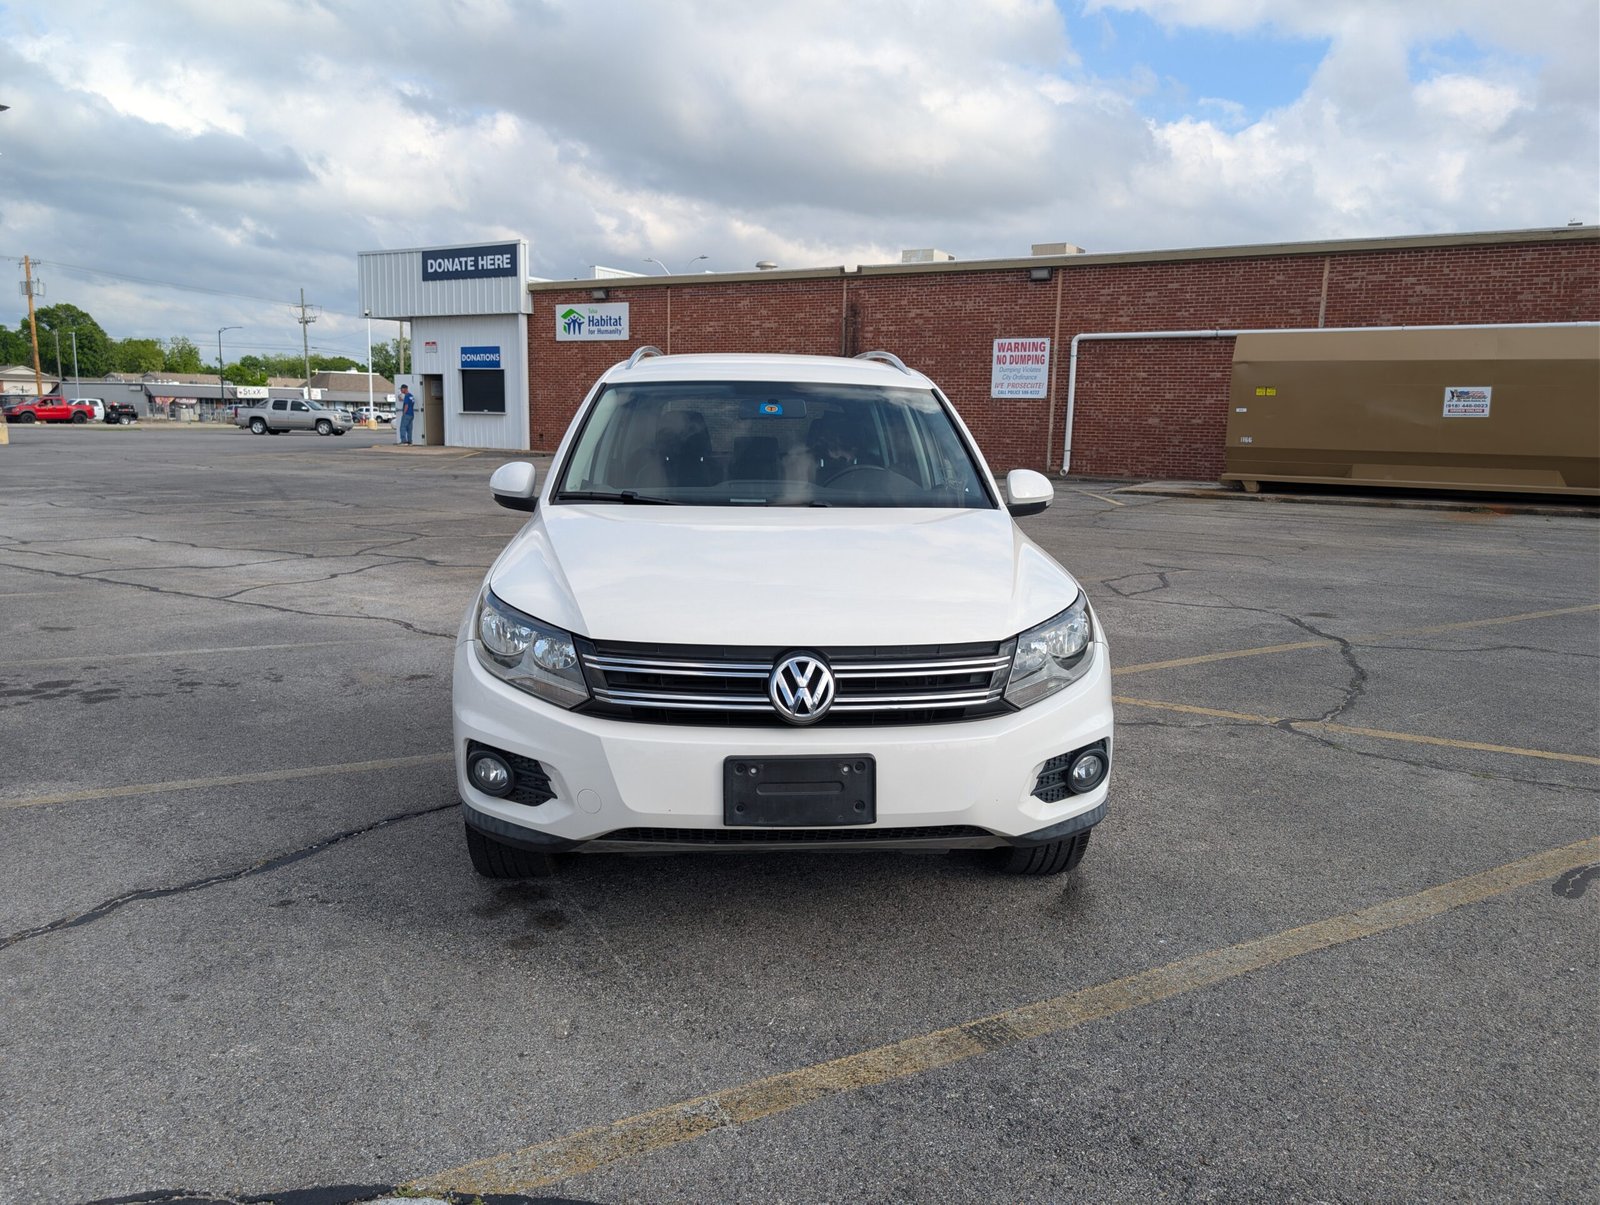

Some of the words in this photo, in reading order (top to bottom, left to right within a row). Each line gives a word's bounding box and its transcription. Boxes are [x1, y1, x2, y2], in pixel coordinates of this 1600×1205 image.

[427, 256, 475, 273] DONATE
[478, 254, 511, 270] HERE
[588, 315, 622, 327] Habitat
[597, 328, 622, 336] Humanity
[997, 341, 1046, 353] WARNING
[461, 353, 500, 362] DONATIONS
[996, 354, 1007, 365] NO
[1009, 354, 1045, 365] DUMPING
[770, 656, 835, 720] VW
